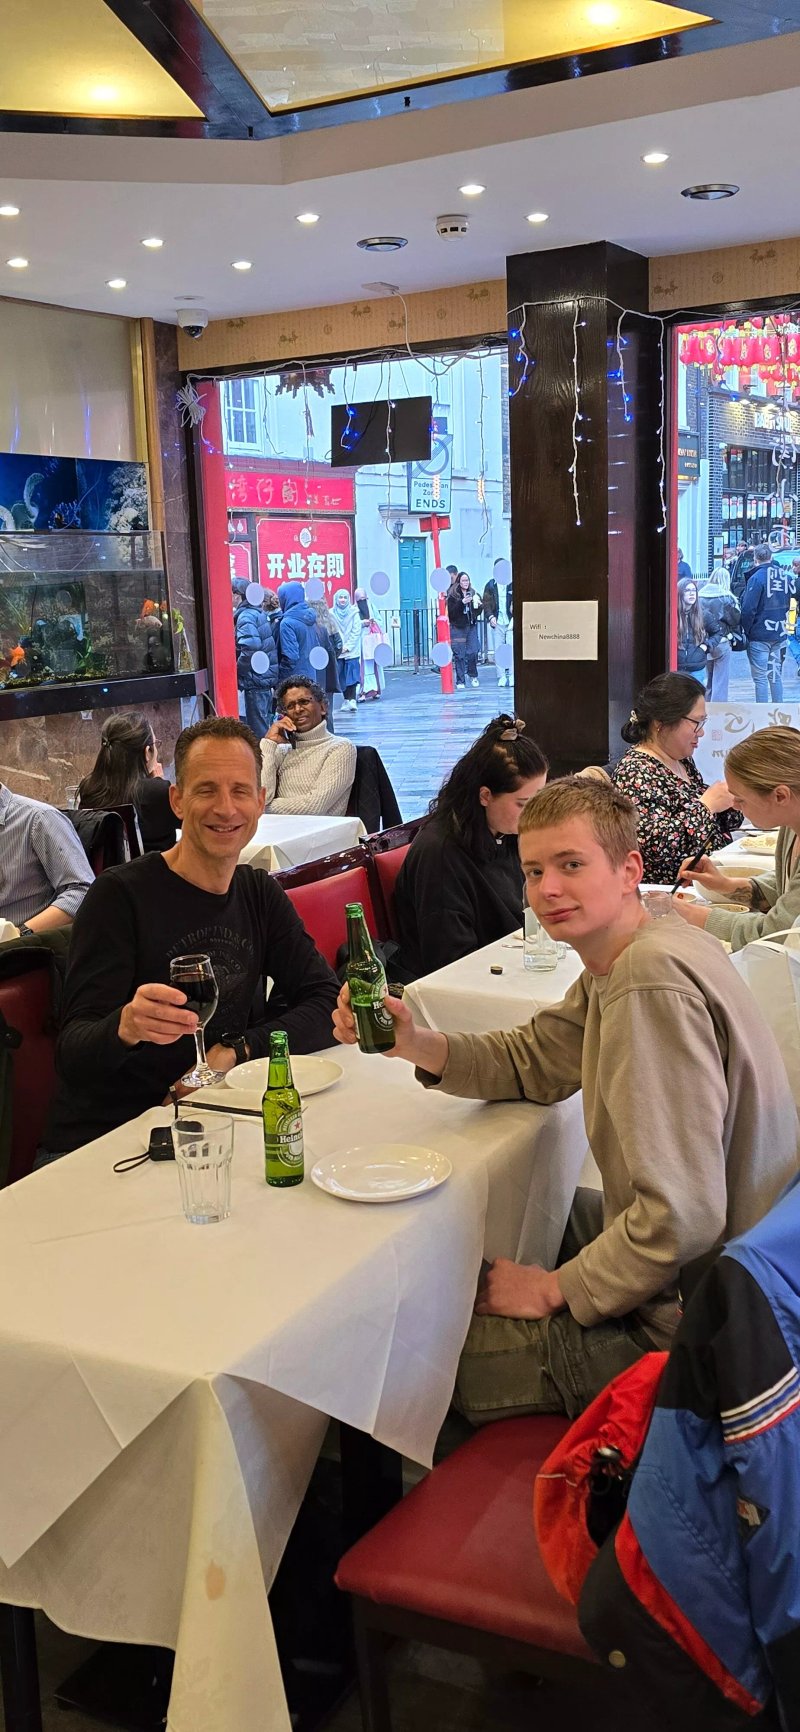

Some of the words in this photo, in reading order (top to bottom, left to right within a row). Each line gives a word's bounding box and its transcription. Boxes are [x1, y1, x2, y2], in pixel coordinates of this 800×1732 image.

[413, 481, 449, 489] Pedesan
[415, 499, 446, 509] ENDS
[267, 552, 345, 579] 开业在即
